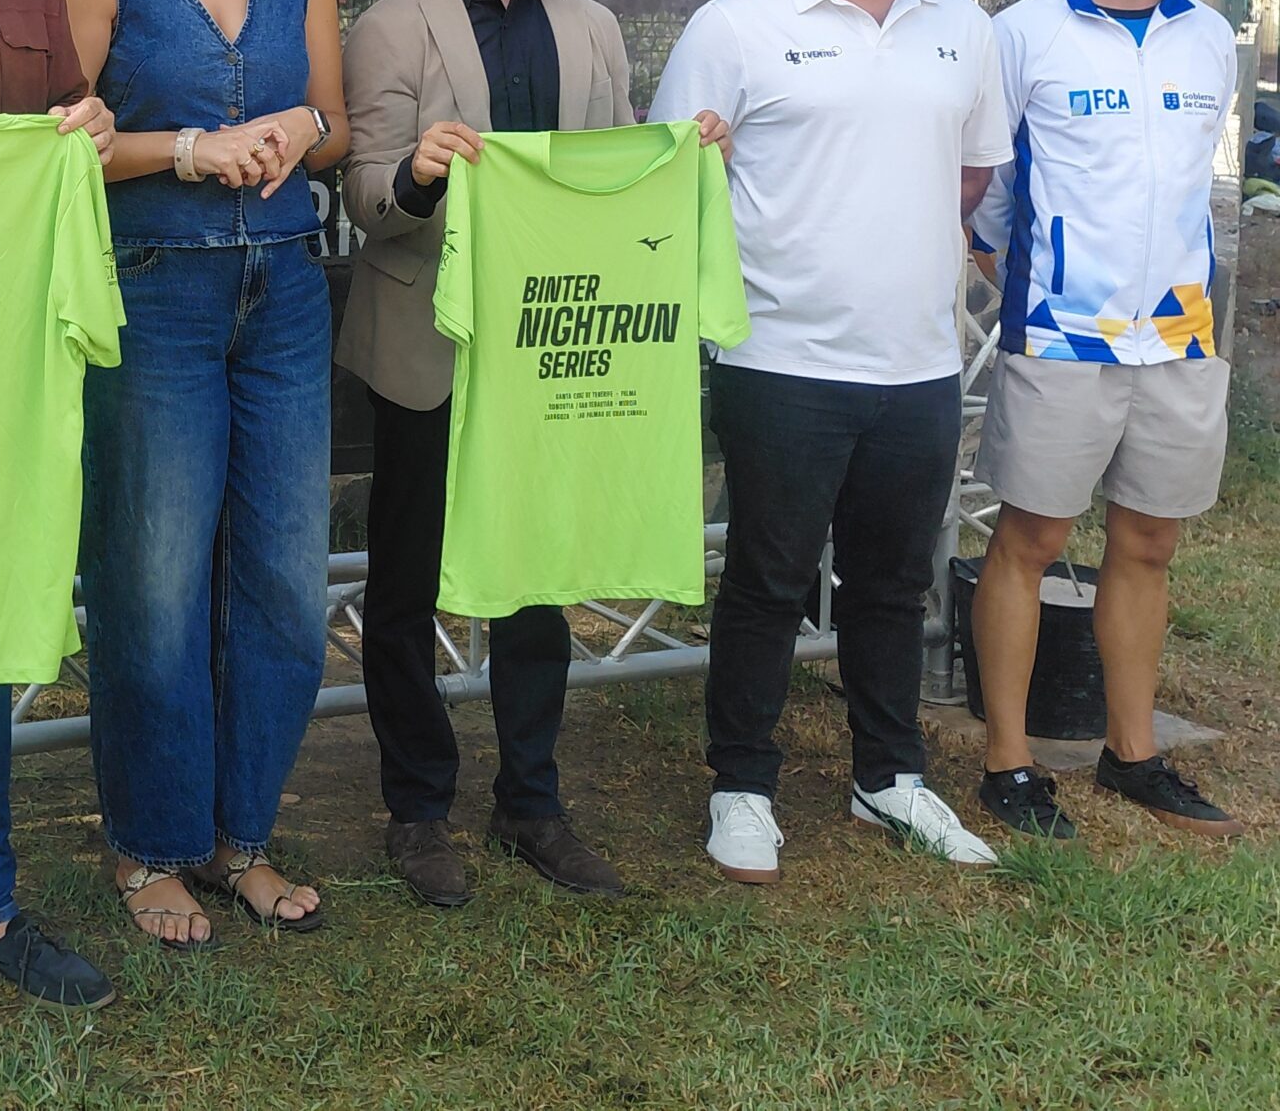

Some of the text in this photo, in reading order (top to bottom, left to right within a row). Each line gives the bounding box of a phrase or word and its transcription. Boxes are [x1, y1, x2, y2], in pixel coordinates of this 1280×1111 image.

[1093, 88, 1130, 109] FCA
[1183, 100, 1193, 108] de
[522, 274, 600, 303] BINTER
[516, 303, 681, 348] NIGHTRUN
[538, 349, 611, 379] SERIES
